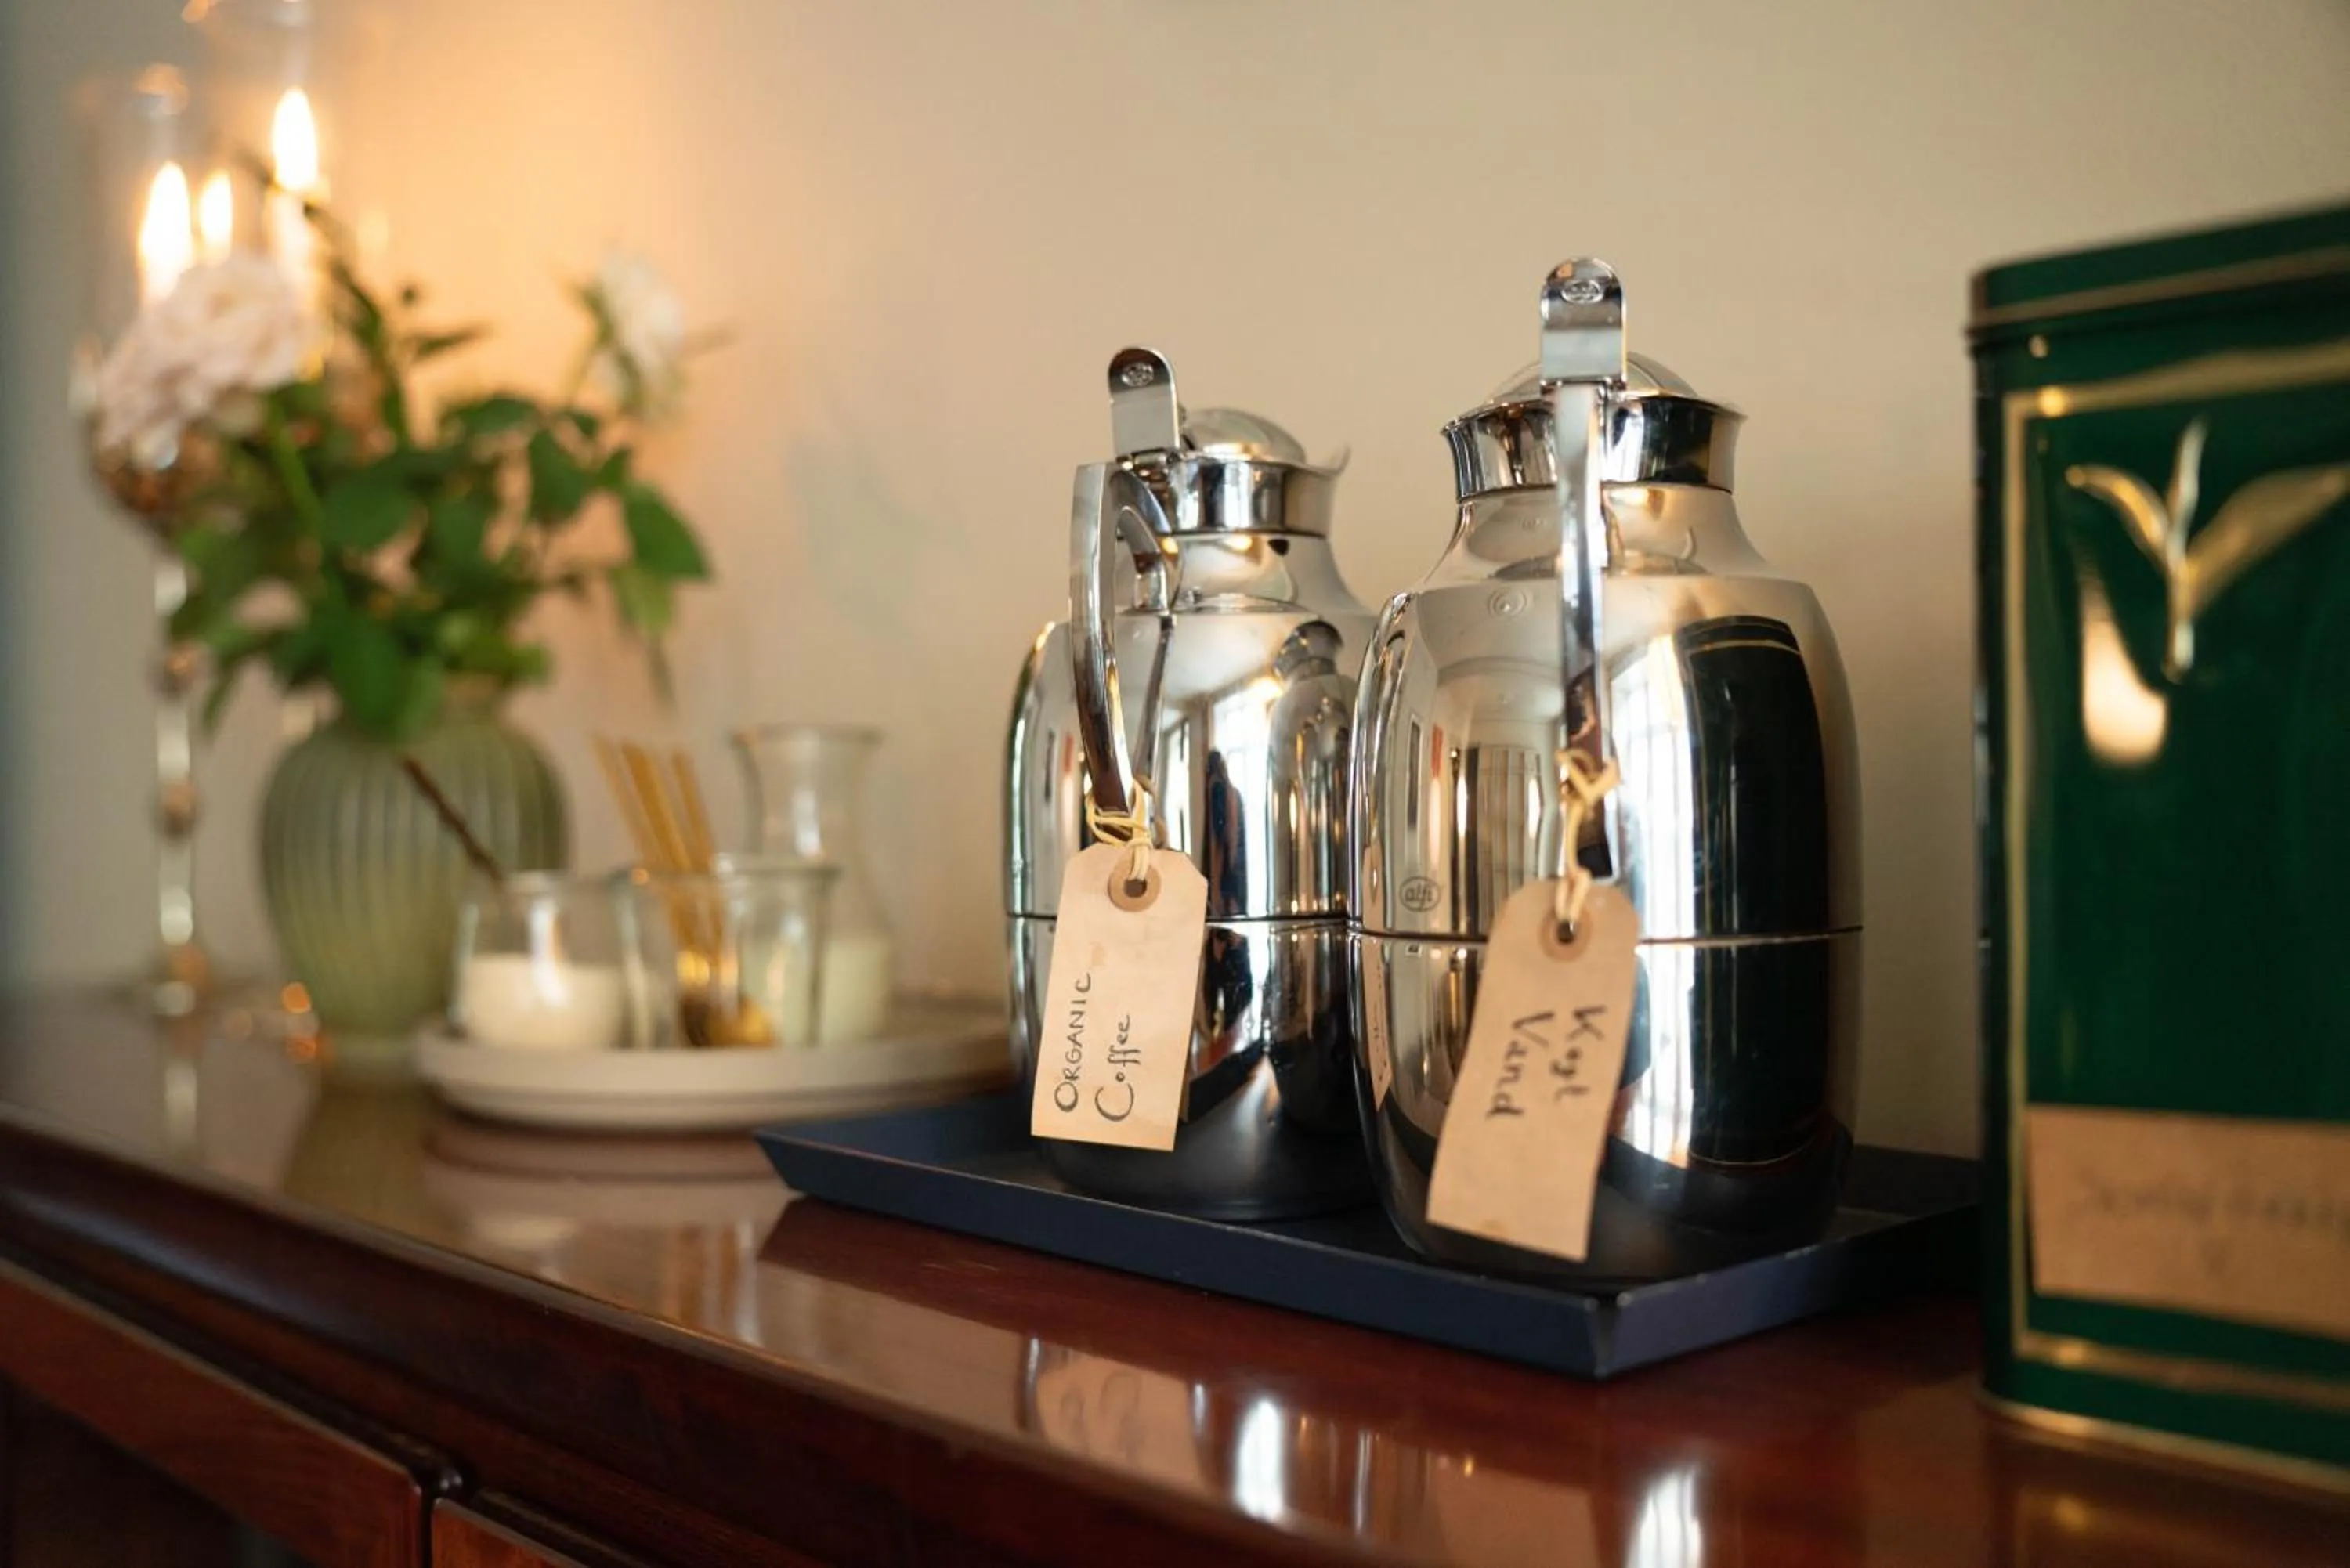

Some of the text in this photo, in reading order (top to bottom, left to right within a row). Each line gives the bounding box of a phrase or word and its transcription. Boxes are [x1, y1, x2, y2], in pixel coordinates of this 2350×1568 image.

[1054, 973, 1091, 1112] ORGANIC
[1095, 1014, 1141, 1122] Coffee
[1486, 1010, 1555, 1118] Vand
